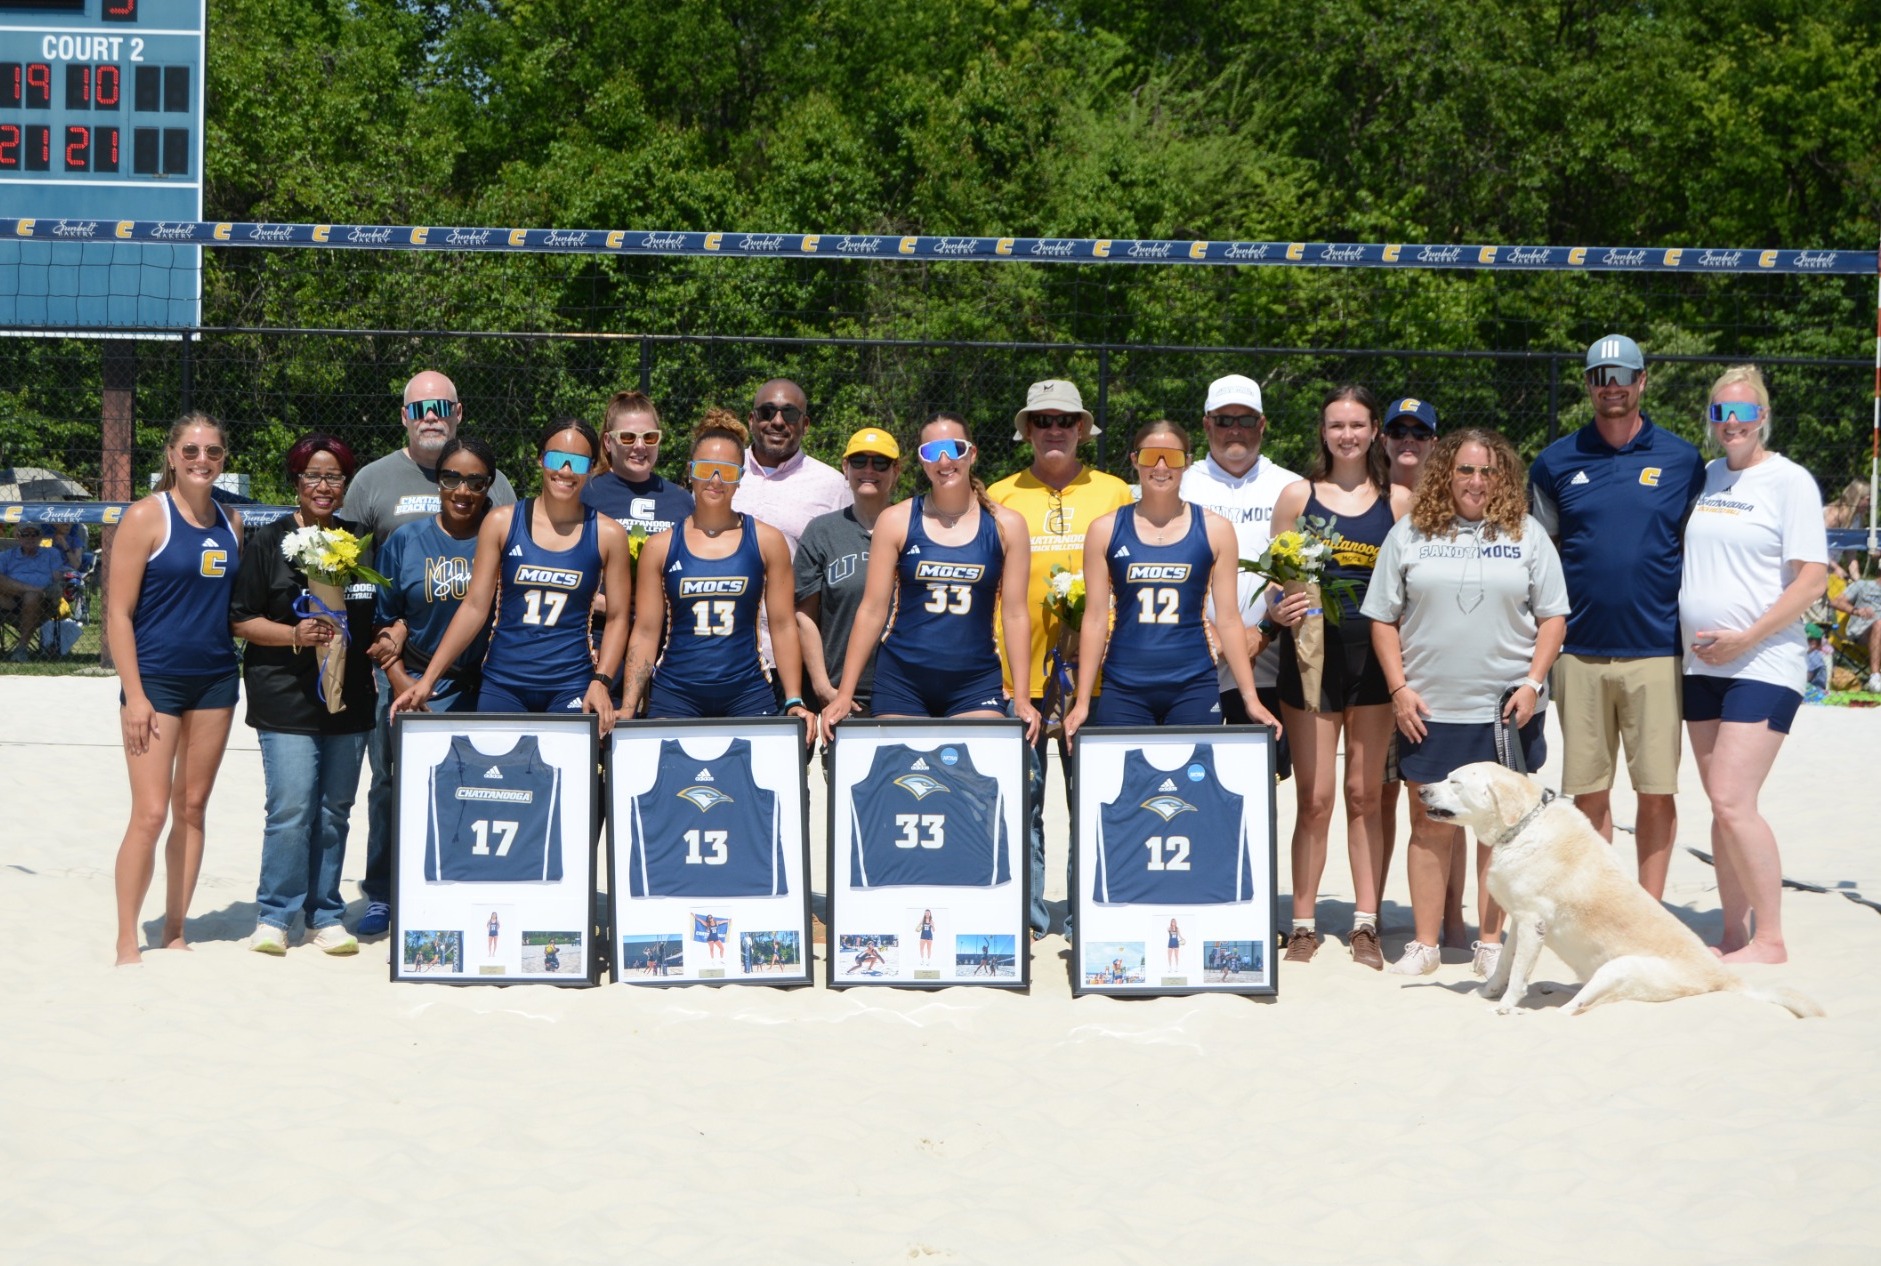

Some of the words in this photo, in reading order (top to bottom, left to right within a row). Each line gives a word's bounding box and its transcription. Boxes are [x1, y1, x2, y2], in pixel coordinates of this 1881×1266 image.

[42, 35, 123, 60] COURT
[130, 38, 145, 61] 2
[14, 63, 49, 101] 19
[83, 65, 119, 105] 10
[0, 125, 48, 162] 21
[66, 126, 118, 166] 21
[16, 219, 35, 236] C
[52, 220, 98, 233] Sunbelt
[115, 221, 134, 238] C
[150, 222, 198, 235] Sunbelt
[213, 223, 232, 240] C
[249, 224, 294, 237] Sunbelt
[311, 225, 331, 242] C
[347, 226, 393, 239] Sunbelt
[445, 228, 491, 241] Sunbelt
[409, 227, 429, 244] C
[508, 229, 528, 246] C
[543, 230, 588, 243] Sunbelt
[605, 231, 625, 248] C
[641, 232, 686, 245] Sunbelt
[703, 233, 723, 250] C
[739, 234, 785, 247] Sunbelt
[801, 235, 819, 252] C
[836, 236, 883, 249] Sunbelt
[898, 237, 918, 254] C
[933, 238, 978, 251] Sunbelt
[995, 238, 1015, 255] C
[1030, 239, 1076, 252] Sunbelt
[1092, 240, 1112, 257] C
[1127, 241, 1172, 254] Sunbelt
[1189, 242, 1209, 258] C
[1224, 243, 1269, 256] Sunbelt
[1286, 243, 1305, 260] C
[1320, 244, 1366, 257] Sunbelt
[1417, 246, 1462, 259] Sunbelt
[1382, 245, 1401, 262] C
[1478, 246, 1498, 263] C
[1506, 247, 1551, 260] Sunbelt
[1567, 248, 1587, 265] C
[1602, 249, 1647, 262] Sunbelt
[1663, 249, 1683, 266] C
[1698, 250, 1742, 263] Sunbelt
[1759, 250, 1778, 267] C
[1793, 251, 1837, 264] Sunbelt
[1639, 466, 1662, 486] C
[4, 506, 23, 522] C
[40, 507, 85, 521] Sunbelt
[102, 507, 121, 524] C
[630, 497, 655, 521] C
[200, 549, 227, 577] C
[518, 568, 578, 587] MOCS
[919, 564, 980, 580] MOCS
[1130, 566, 1187, 579] MOCS
[683, 580, 743, 594] MOCS
[924, 582, 972, 615] 33
[1136, 587, 1179, 624] 12
[523, 589, 568, 626] 17
[692, 600, 736, 635] 13
[457, 789, 531, 801] CHATTANOOGA
[470, 820, 519, 856] 17
[895, 814, 945, 849] 33
[683, 829, 728, 865] 13
[1145, 836, 1191, 871] 12
